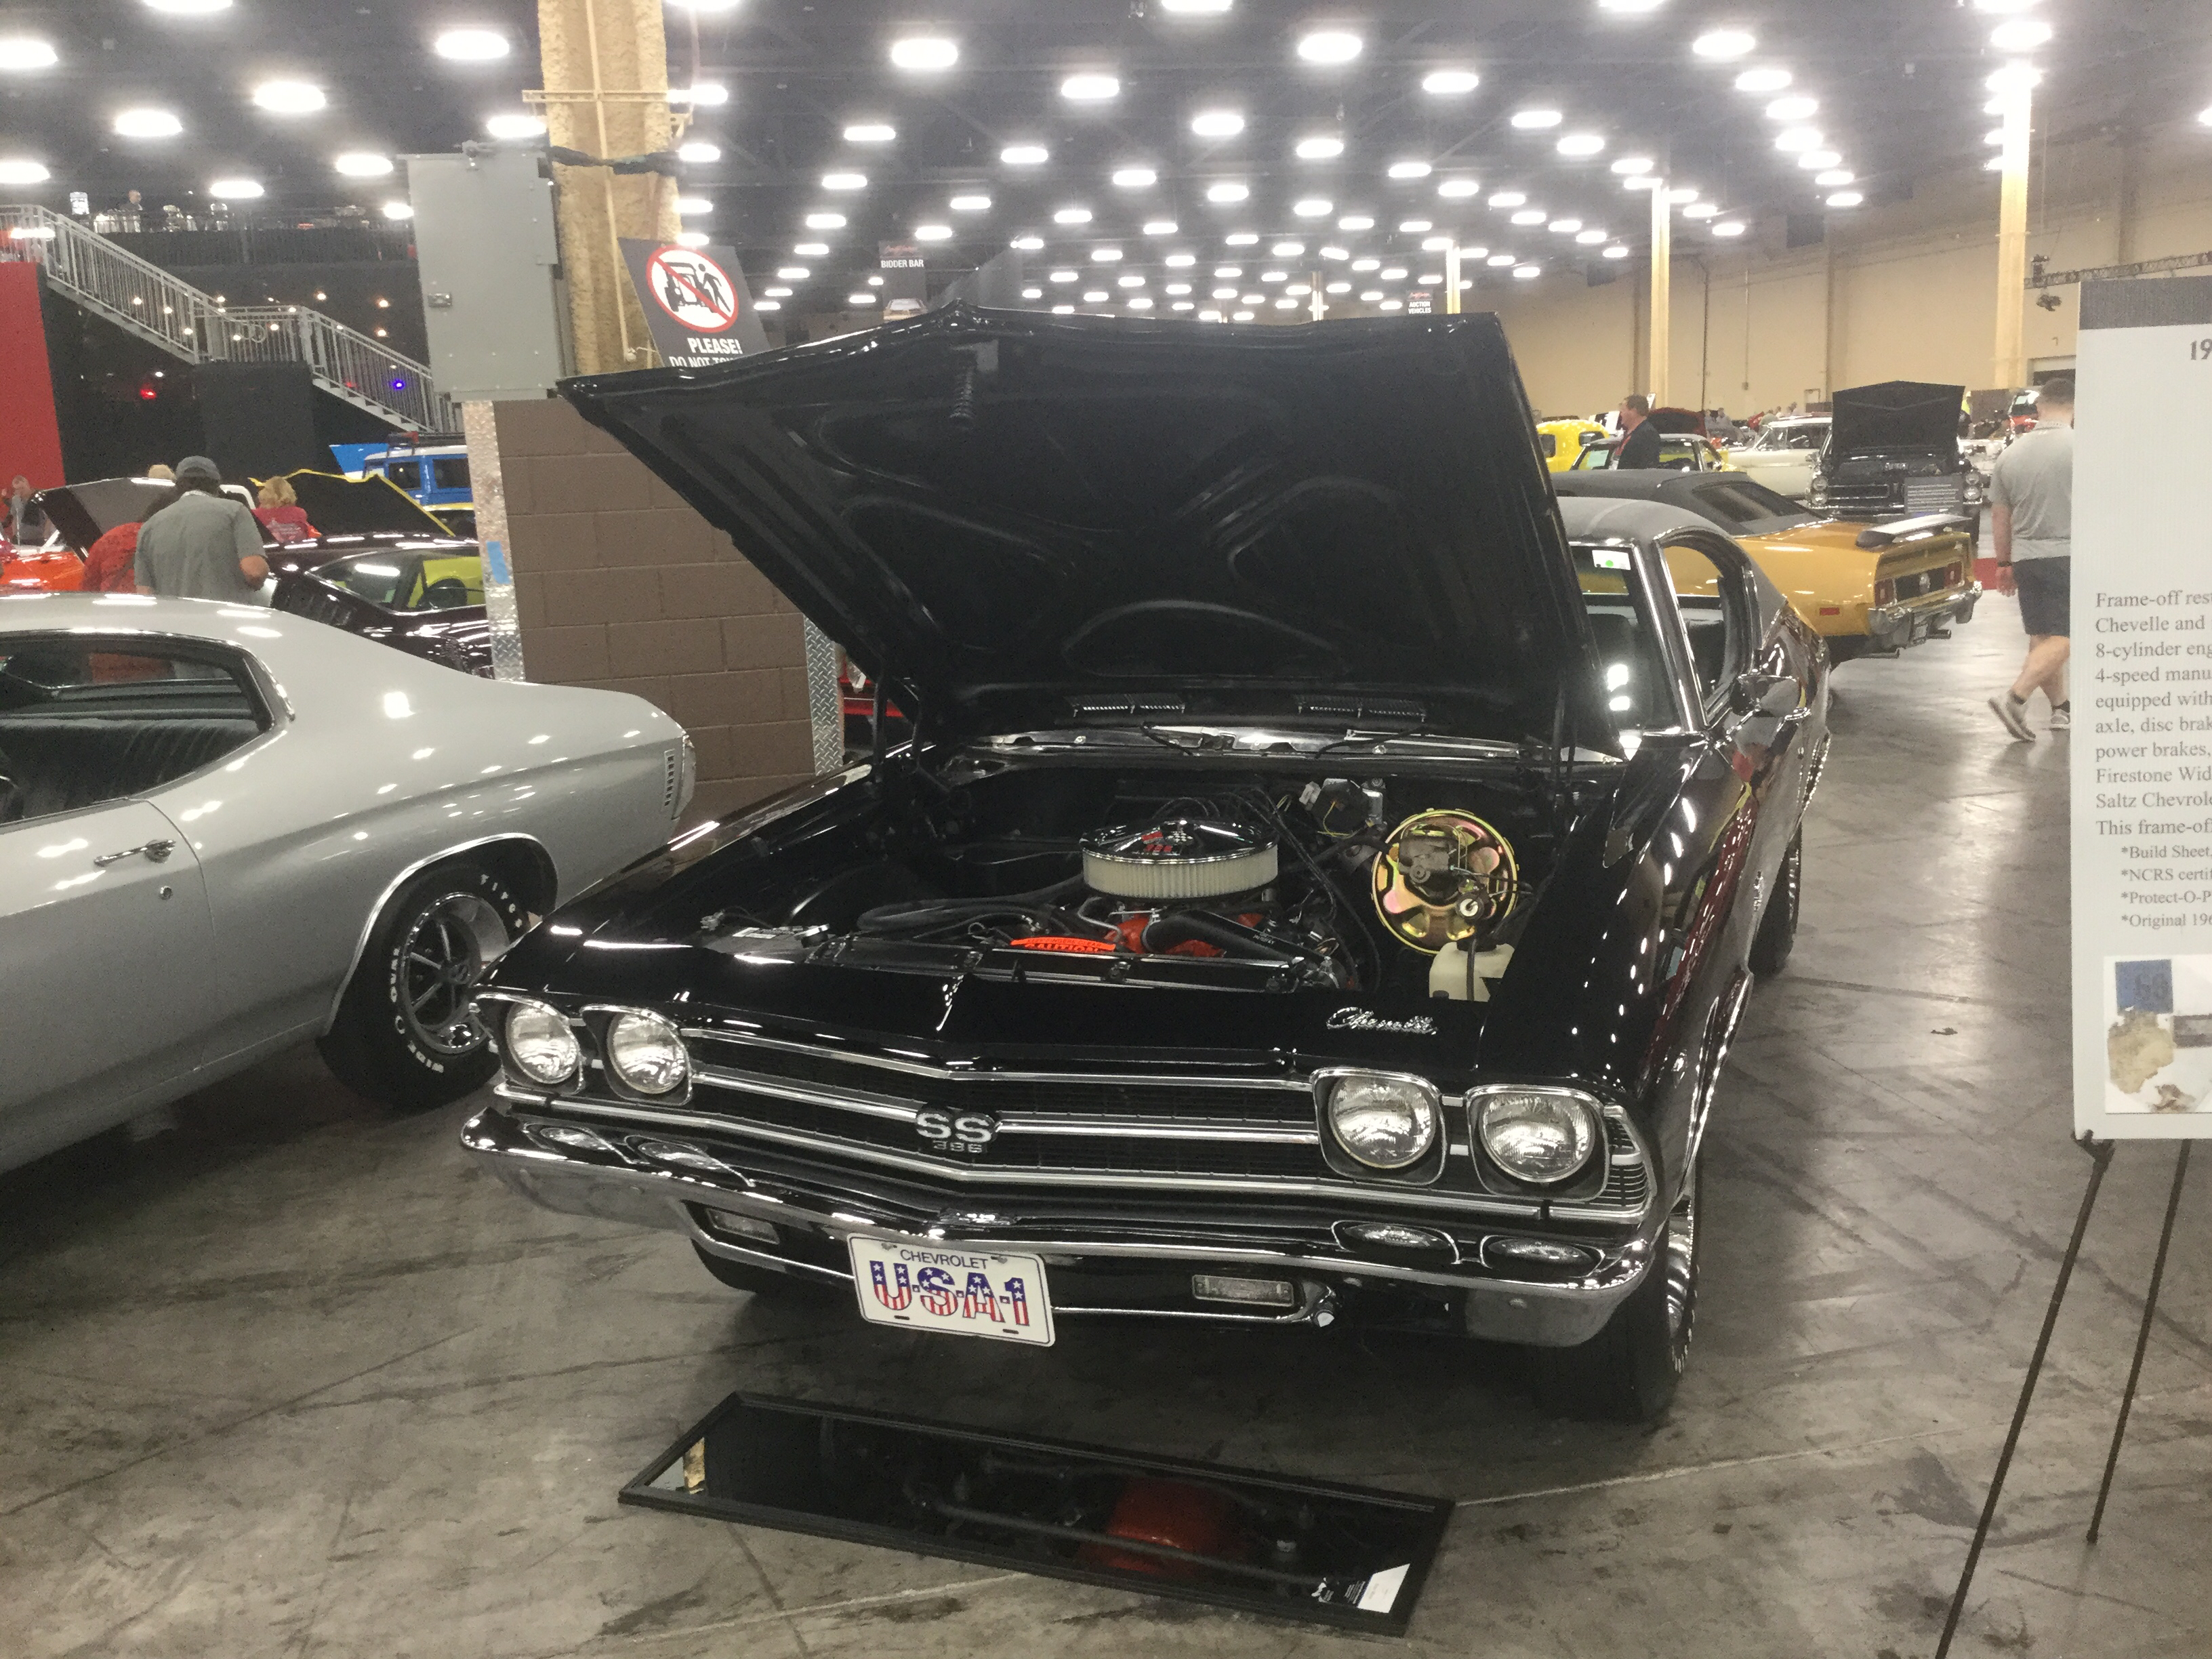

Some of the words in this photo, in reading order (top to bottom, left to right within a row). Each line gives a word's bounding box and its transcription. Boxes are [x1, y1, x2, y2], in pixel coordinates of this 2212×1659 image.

[881, 260, 907, 268] BIDDER
[909, 259, 924, 268] BAR
[687, 337, 743, 354] PLEASE!
[2190, 338, 2212, 360] 19
[669, 356, 687, 367] DO
[688, 356, 710, 367] NOT
[2095, 590, 2183, 607] Frame-off
[2186, 594, 2212, 605] res
[2095, 615, 2169, 633] Chevelle
[2175, 615, 2205, 630] and
[2095, 641, 2182, 661] 8-cylinder
[2095, 666, 2160, 687] 4-speed
[2095, 691, 2171, 712] equipped
[2177, 690, 2212, 705] with
[2095, 717, 2135, 734] axle,
[2140, 717, 2173, 732] disc
[2095, 746, 2148, 762] power
[2152, 741, 2211, 758] brakes,
[2096, 768, 2173, 783] Firestone
[2095, 793, 2137, 808] Saltz
[2095, 820, 2132, 835] This
[916, 1112, 994, 1143] SS
[900, 1249, 989, 1270] CHEVROLET
